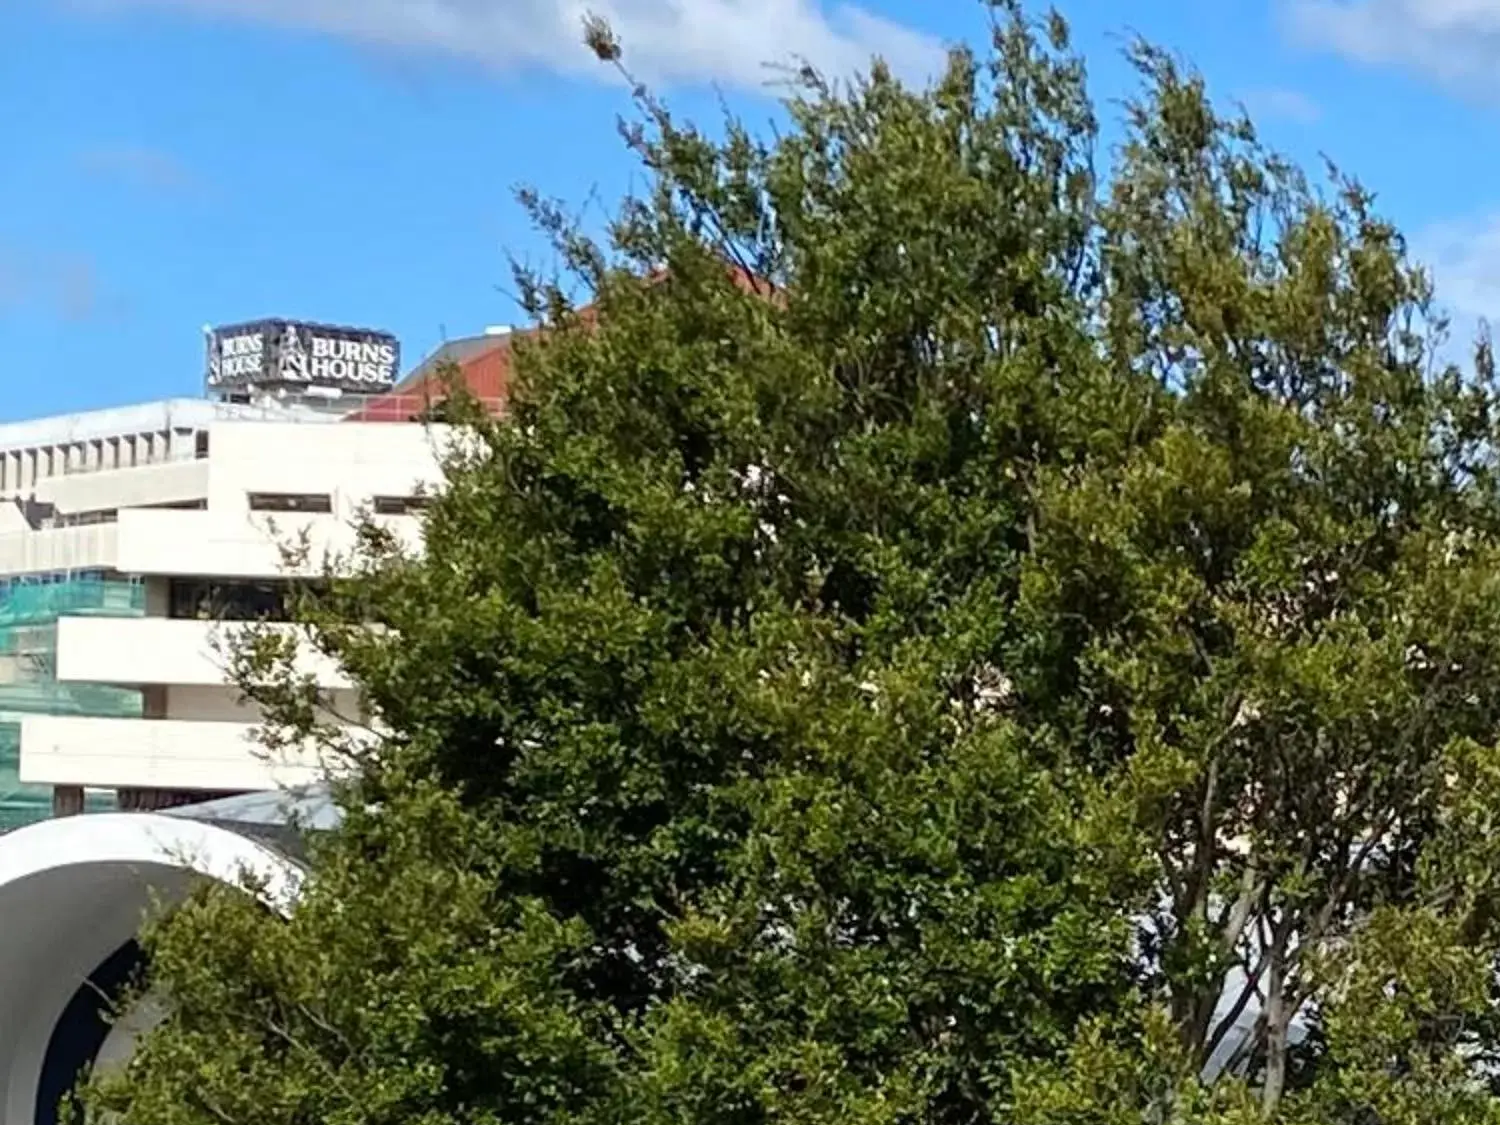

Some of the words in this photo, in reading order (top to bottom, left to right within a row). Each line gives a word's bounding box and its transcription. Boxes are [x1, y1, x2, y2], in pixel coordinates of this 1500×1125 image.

[222, 333, 263, 355] BURNS
[312, 337, 395, 363] BURNS
[222, 354, 262, 376] HOUSE
[311, 359, 393, 384] HOUSE
